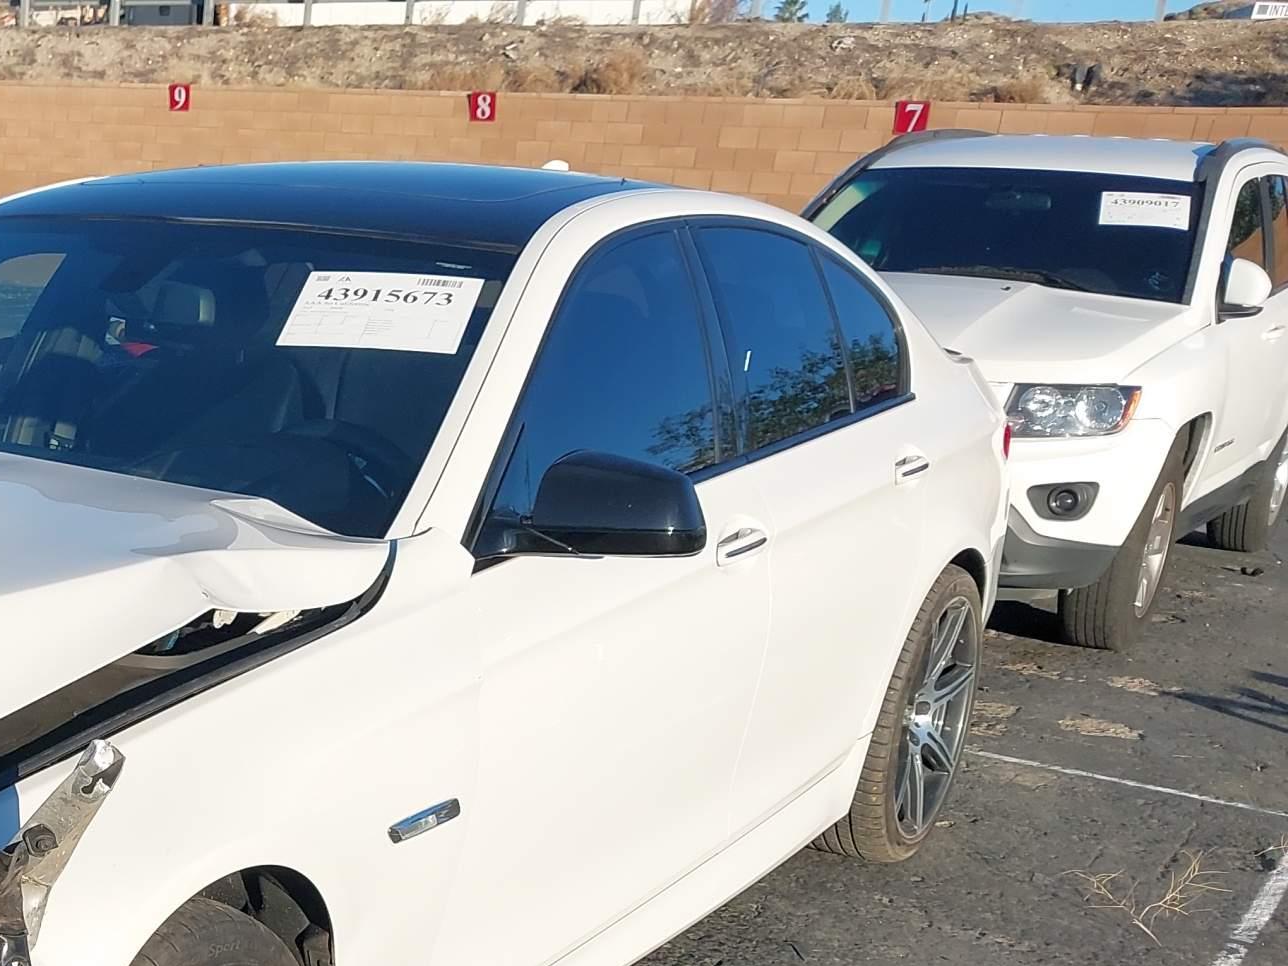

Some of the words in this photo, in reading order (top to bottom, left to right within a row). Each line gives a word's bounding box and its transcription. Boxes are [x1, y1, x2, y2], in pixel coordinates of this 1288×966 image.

[173, 86, 186, 110] 9
[475, 94, 491, 120] 8
[904, 103, 925, 133] 7
[316, 286, 454, 307] 43915673
